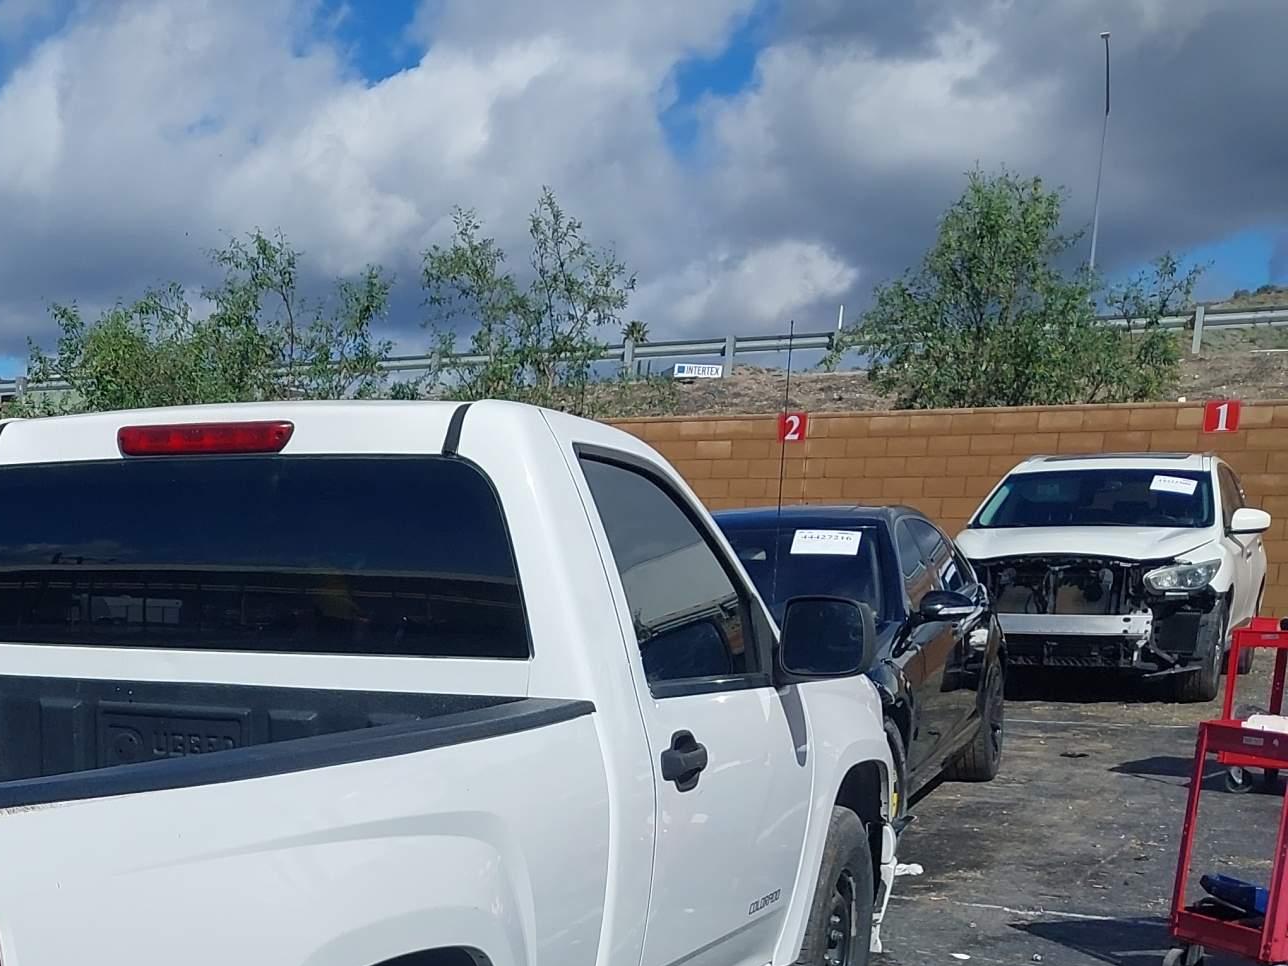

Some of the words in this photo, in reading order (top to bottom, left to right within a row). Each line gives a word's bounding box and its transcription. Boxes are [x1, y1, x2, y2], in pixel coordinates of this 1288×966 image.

[686, 366, 720, 376] INTERTEX
[784, 415, 801, 440] 2
[1213, 403, 1230, 430] 1
